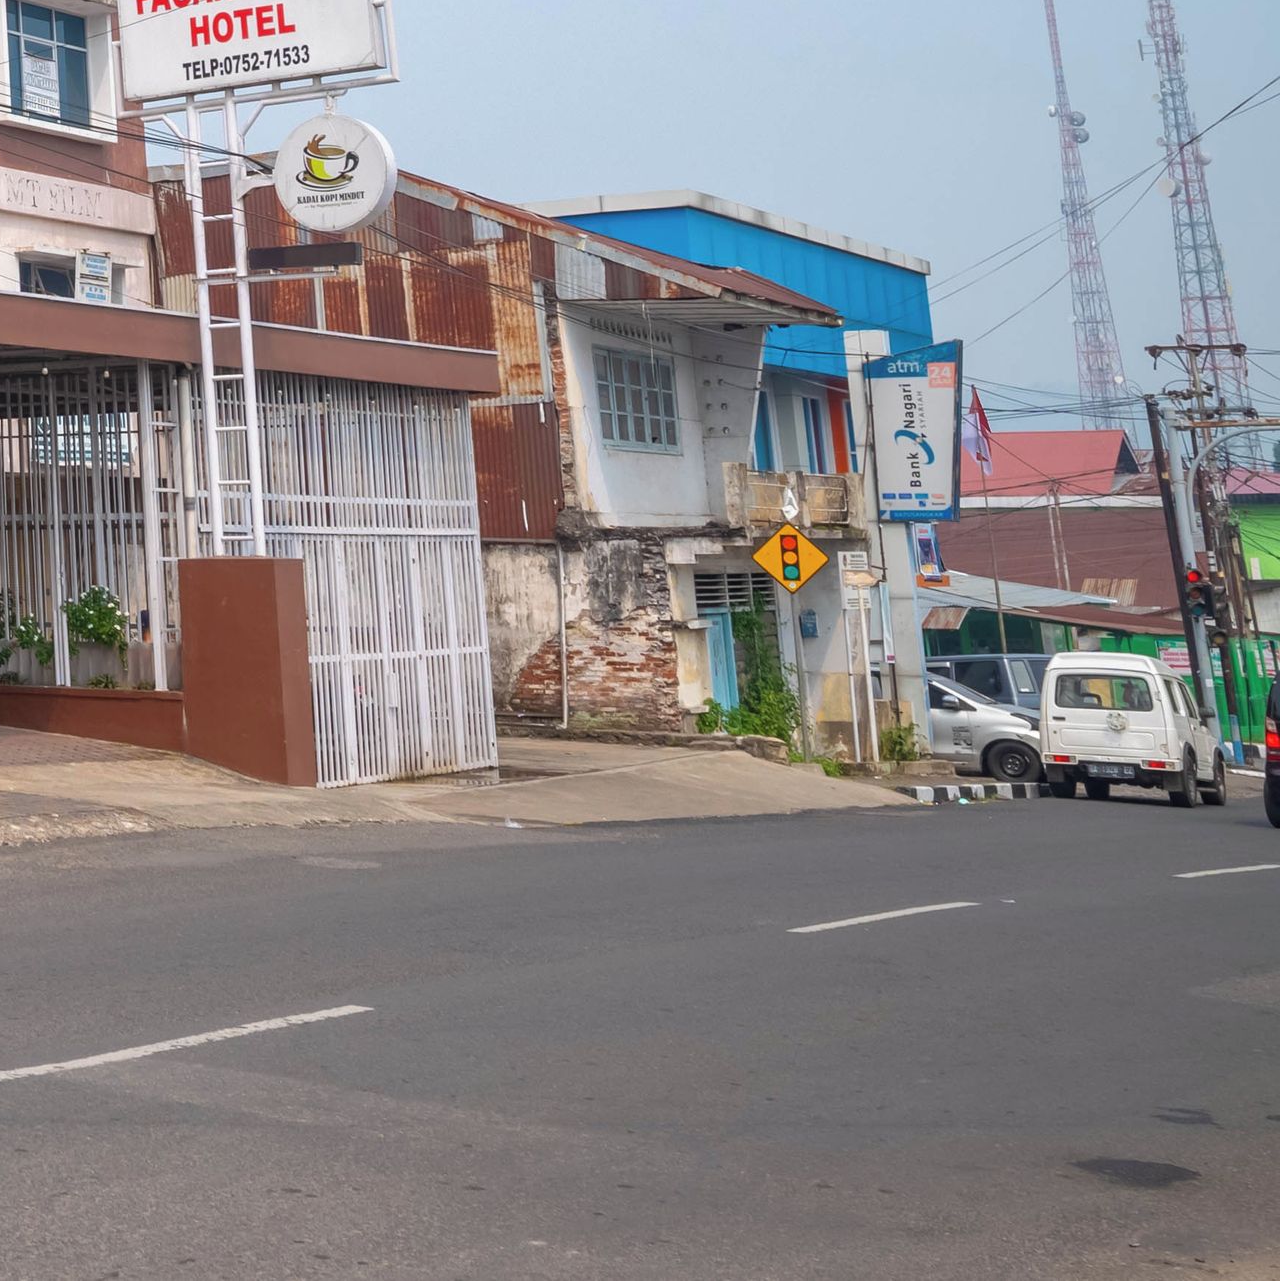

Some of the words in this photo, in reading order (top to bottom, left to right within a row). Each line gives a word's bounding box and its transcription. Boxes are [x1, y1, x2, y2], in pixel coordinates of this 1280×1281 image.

[189, 3, 296, 47] HOTEL
[182, 44, 311, 81] TELP:0752-71533
[297, 196, 319, 205] KADAI
[320, 193, 338, 202] KOPI
[339, 192, 365, 201] MINDUT
[887, 359, 920, 374] atm
[929, 365, 952, 377] 24
[898, 383, 917, 429] Nagari
[916, 390, 927, 429] SYARIAH
[906, 452, 922, 488] Bank
